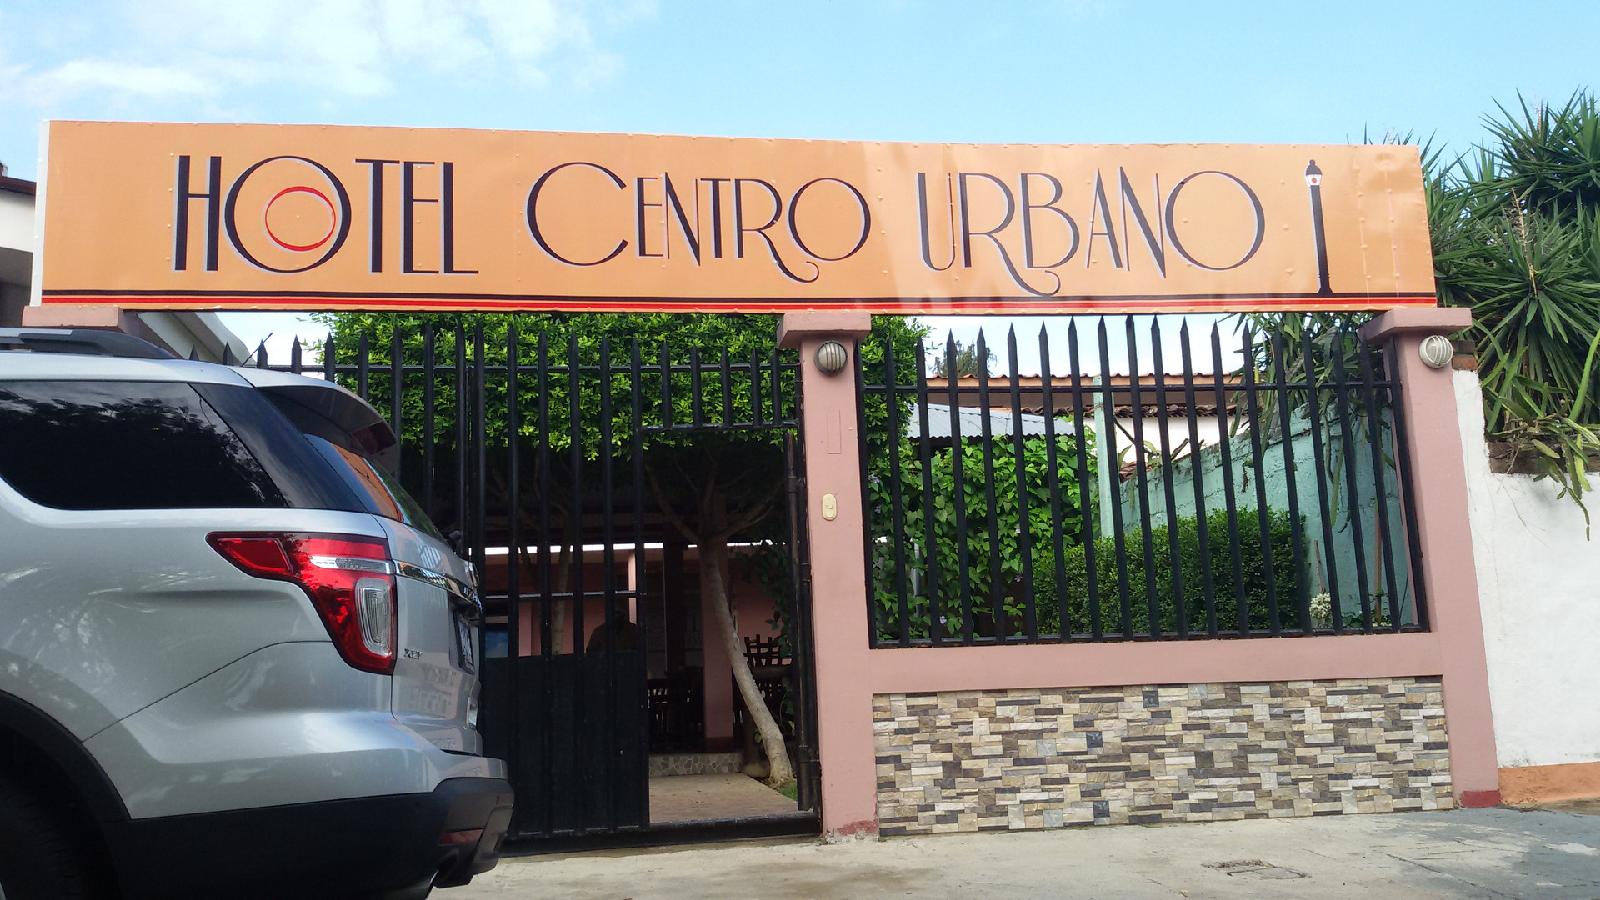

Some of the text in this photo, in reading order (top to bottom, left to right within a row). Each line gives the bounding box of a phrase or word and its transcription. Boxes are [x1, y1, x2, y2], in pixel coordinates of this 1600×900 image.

[174, 155, 1266, 297] HOTEL CENTRO URBANO
